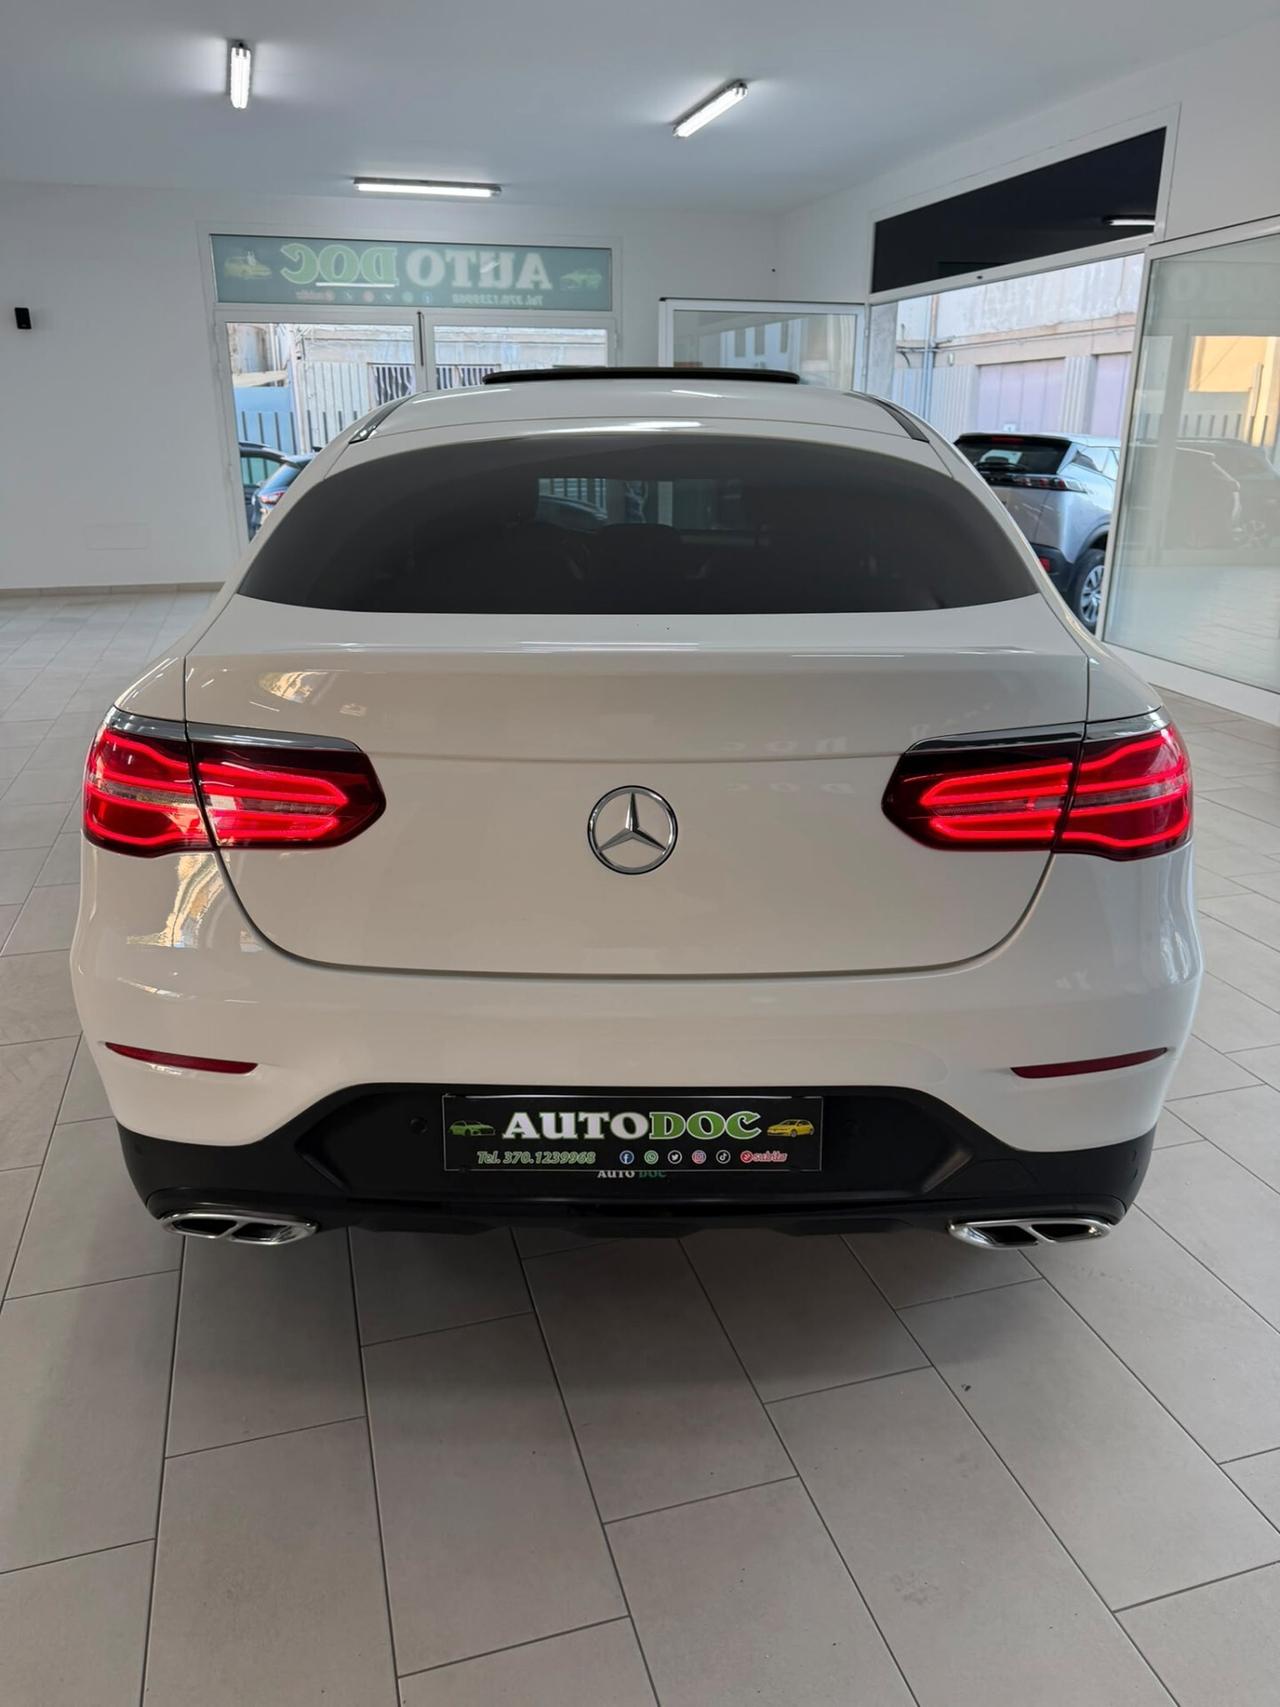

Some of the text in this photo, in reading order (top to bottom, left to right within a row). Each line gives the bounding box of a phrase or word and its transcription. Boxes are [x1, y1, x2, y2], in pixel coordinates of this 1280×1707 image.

[477, 1150, 597, 1164] Tel. 370.1239968
[597, 1170, 636, 1179] AUTO
